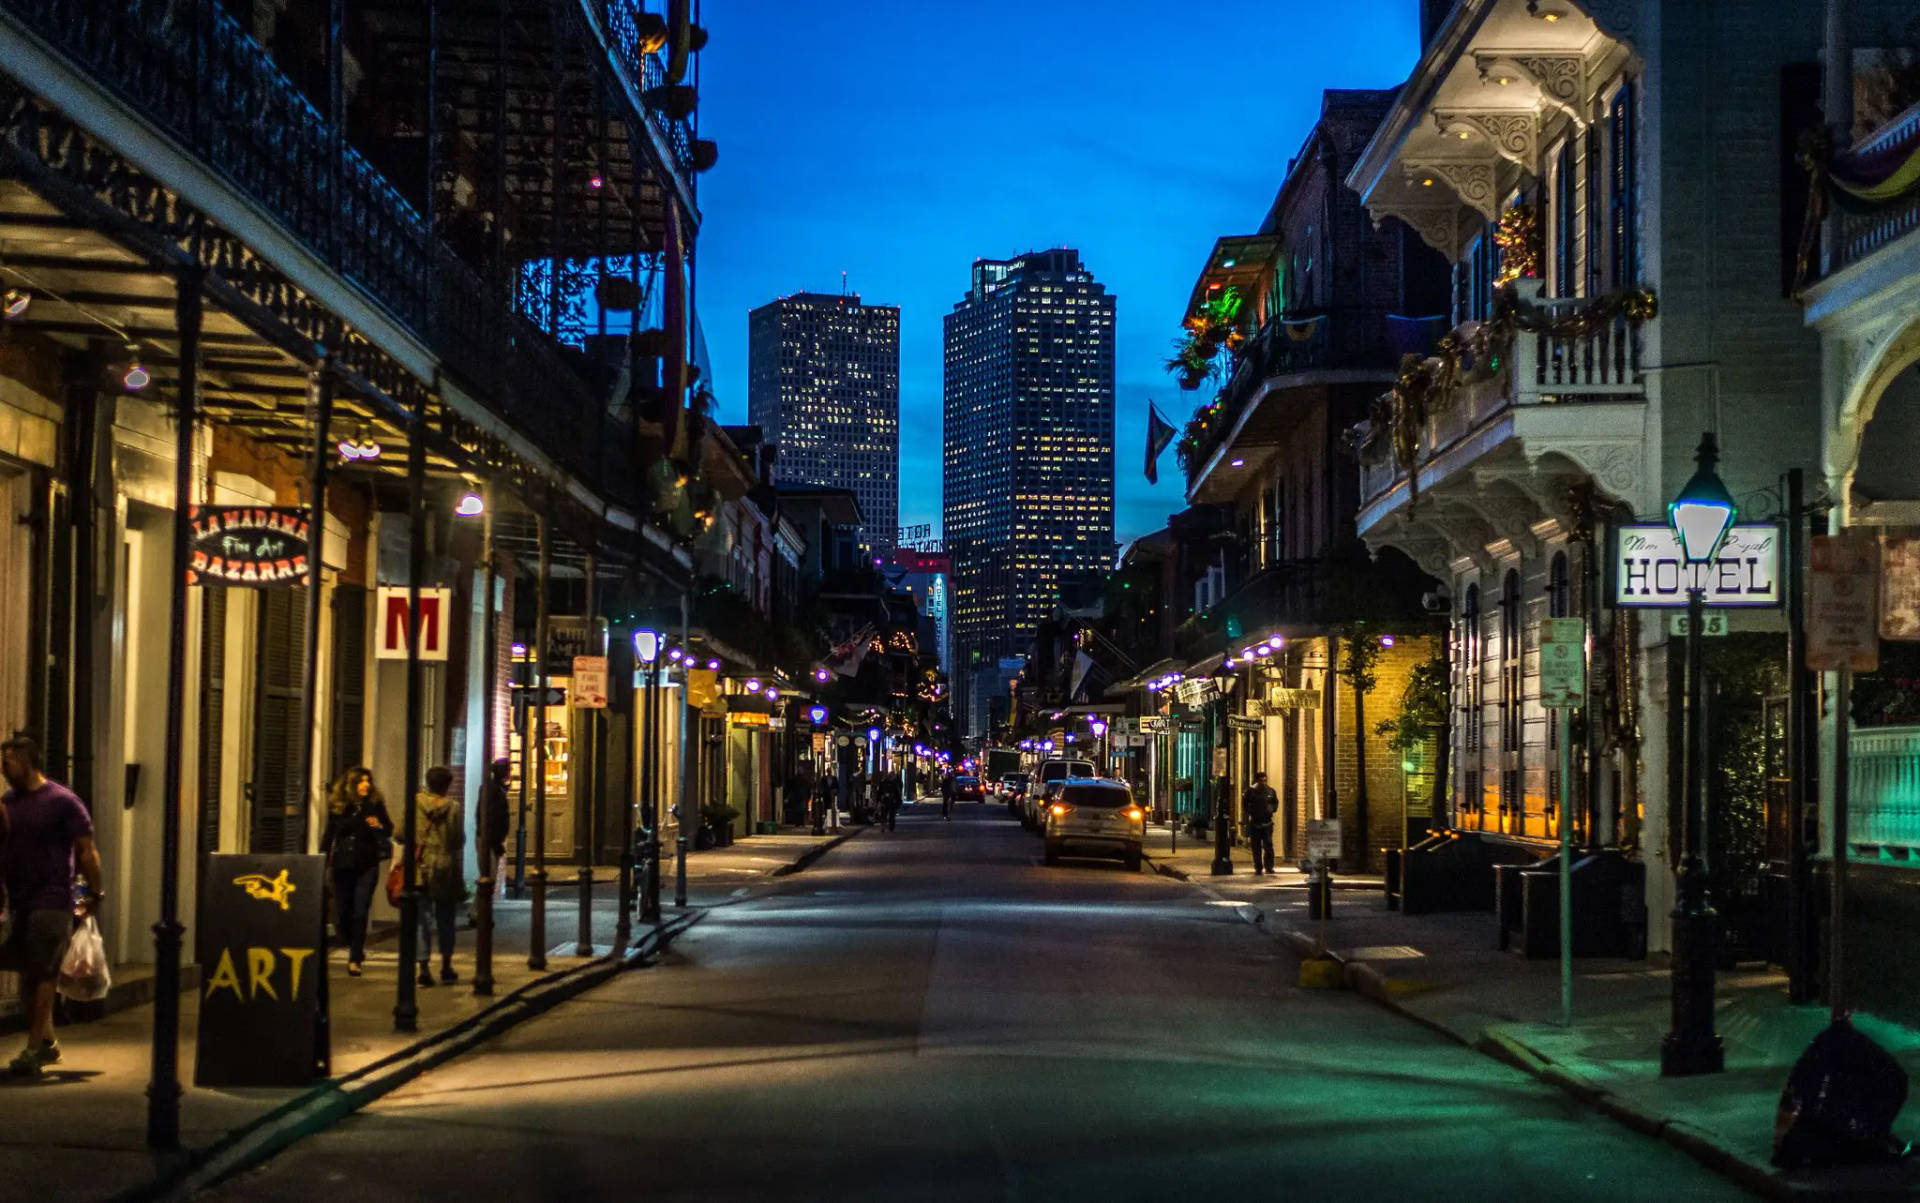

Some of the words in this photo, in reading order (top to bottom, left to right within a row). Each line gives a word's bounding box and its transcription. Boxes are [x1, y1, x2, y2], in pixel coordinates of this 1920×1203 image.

[192, 514, 221, 540] LA
[222, 535, 251, 556] Fine
[256, 536, 285, 557] Art
[190, 549, 309, 580] BAZARRE
[1624, 558, 1772, 595] HOTEL
[385, 596, 440, 652] M
[205, 946, 316, 1004] ART
